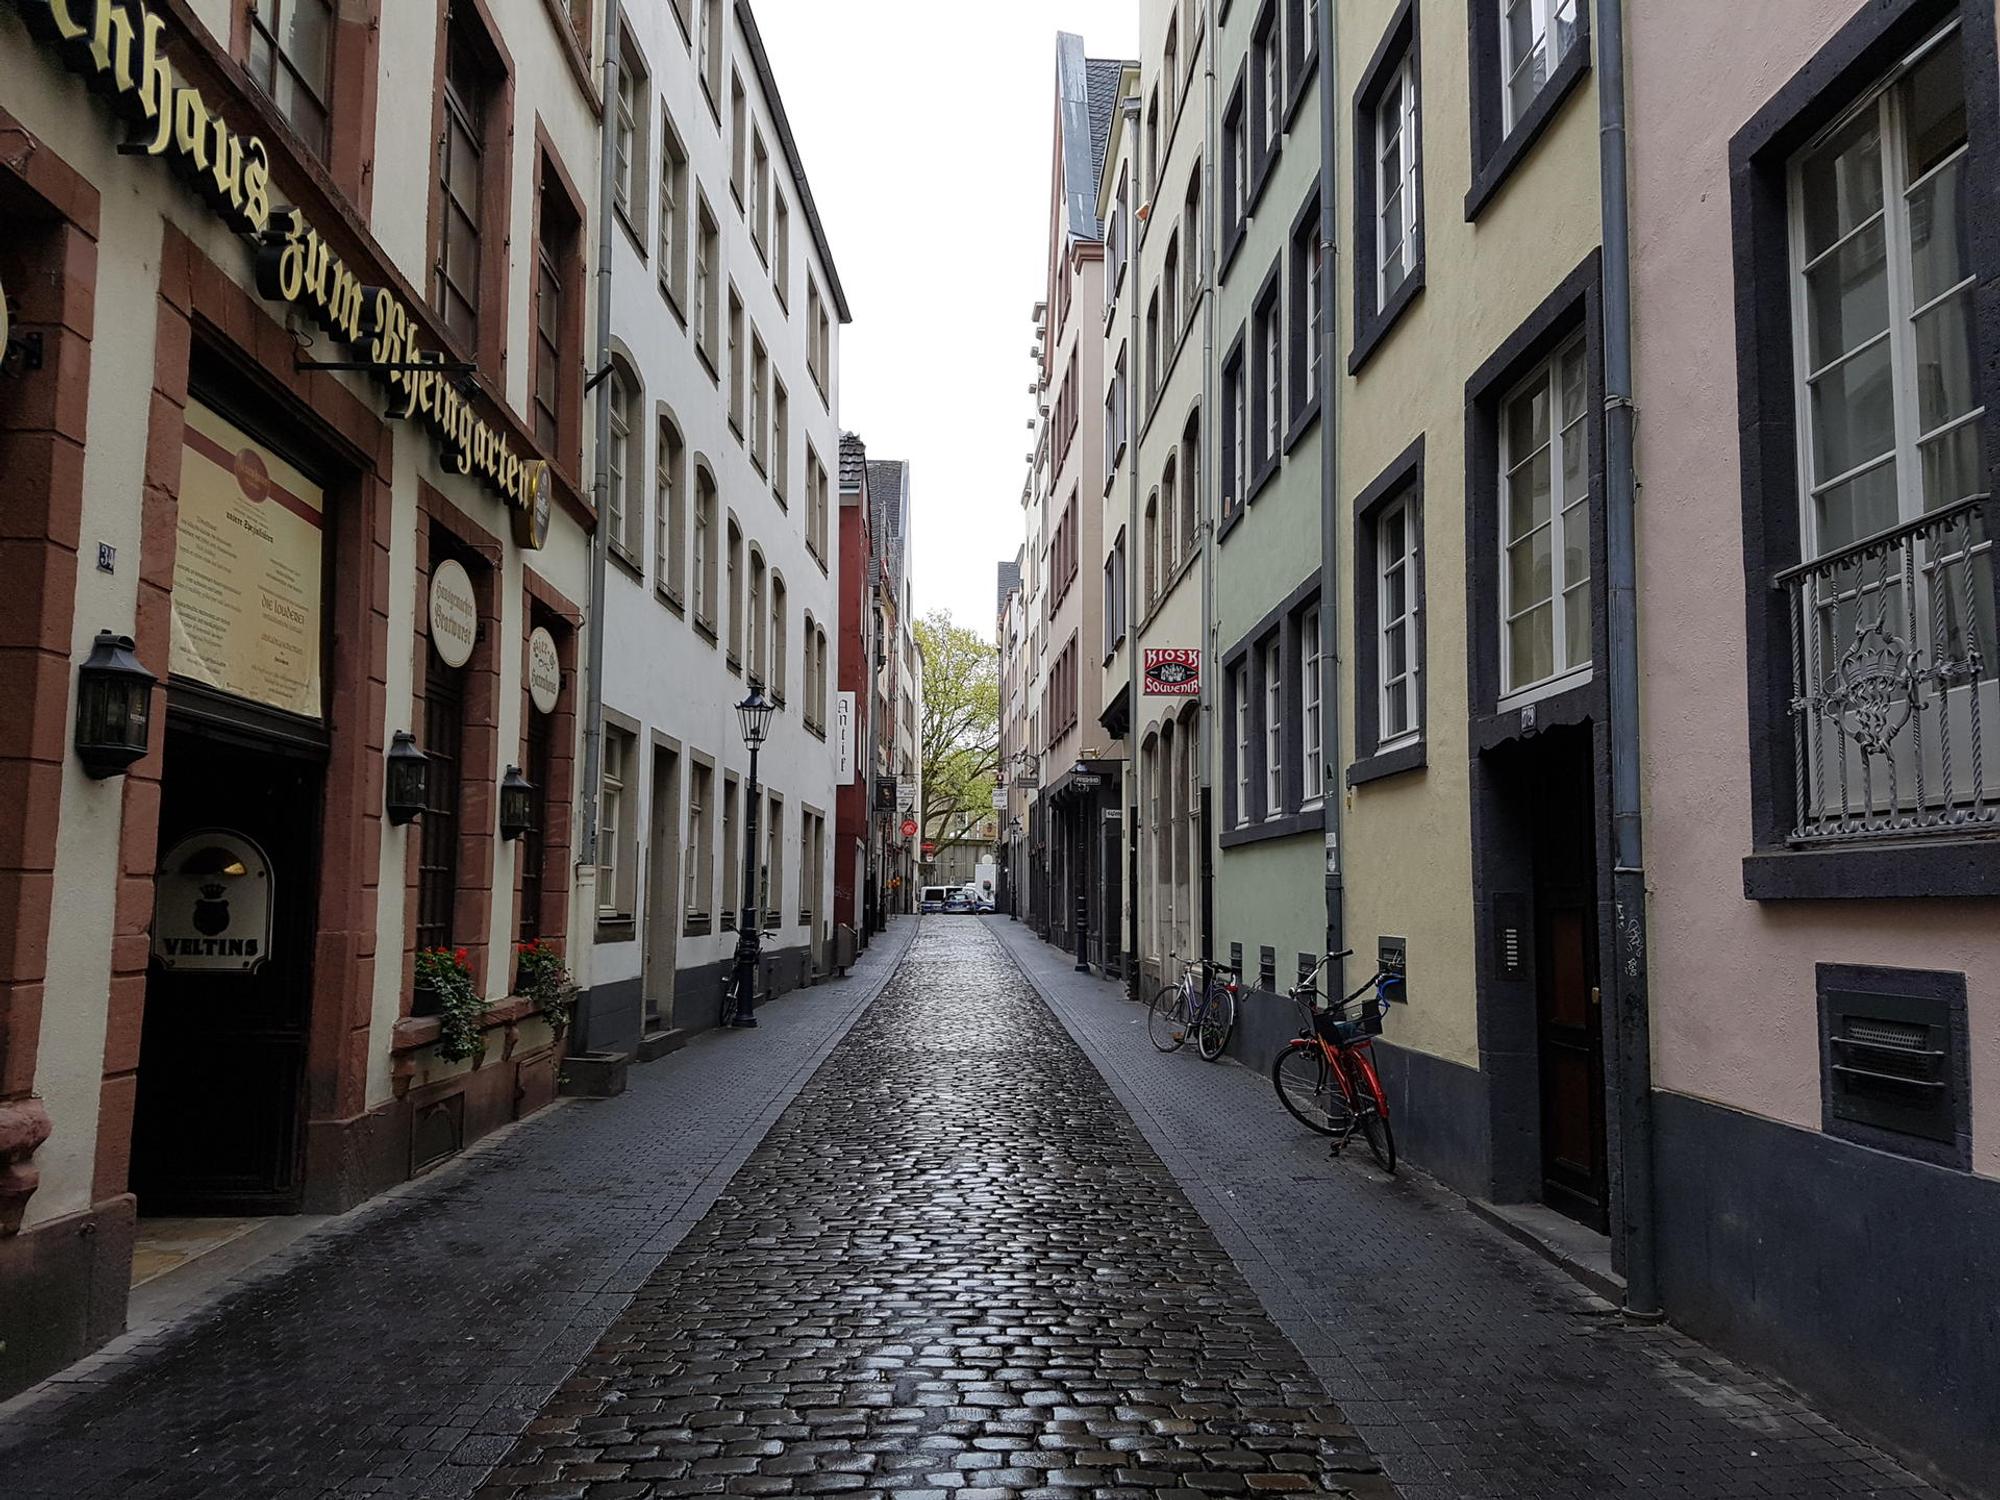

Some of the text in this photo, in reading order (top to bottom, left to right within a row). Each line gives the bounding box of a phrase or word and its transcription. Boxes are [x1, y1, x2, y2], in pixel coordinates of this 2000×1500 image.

[280, 209, 364, 343] zum
[372, 287, 530, 510] Rheingarten
[1146, 650, 1198, 668] KIOSK
[163, 937, 258, 957] VELTINS
